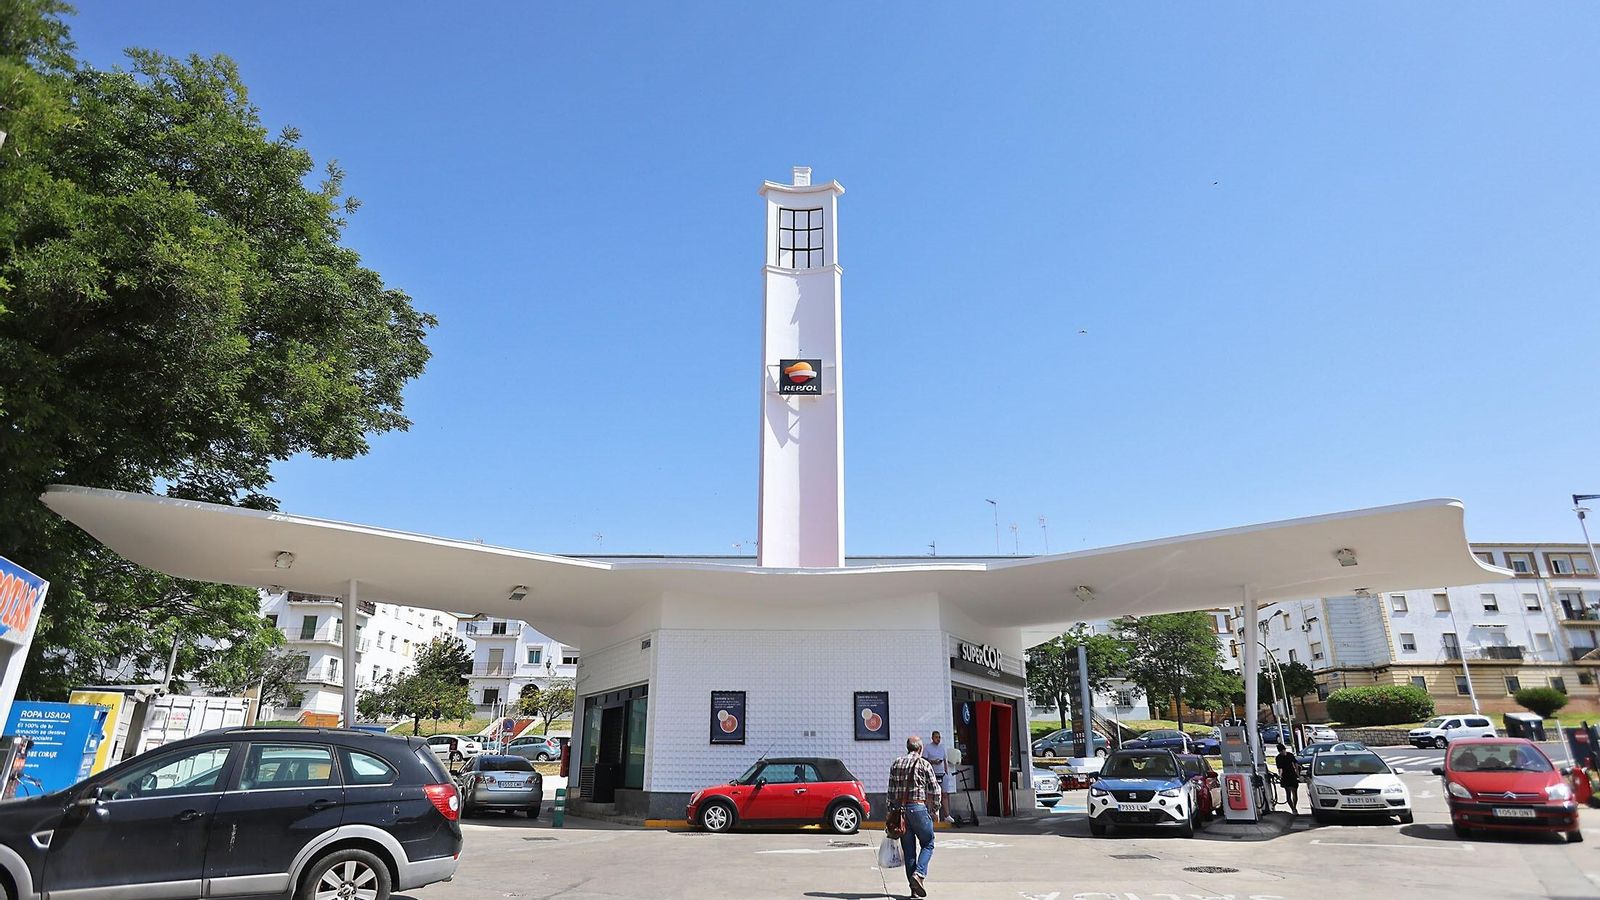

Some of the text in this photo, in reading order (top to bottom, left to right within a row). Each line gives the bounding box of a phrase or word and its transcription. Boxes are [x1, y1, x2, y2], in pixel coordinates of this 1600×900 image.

[962, 642, 1004, 671] SUPERCOR
[20, 710, 71, 719] ROPA USADA
[1223, 719, 1242, 727] 6 7
